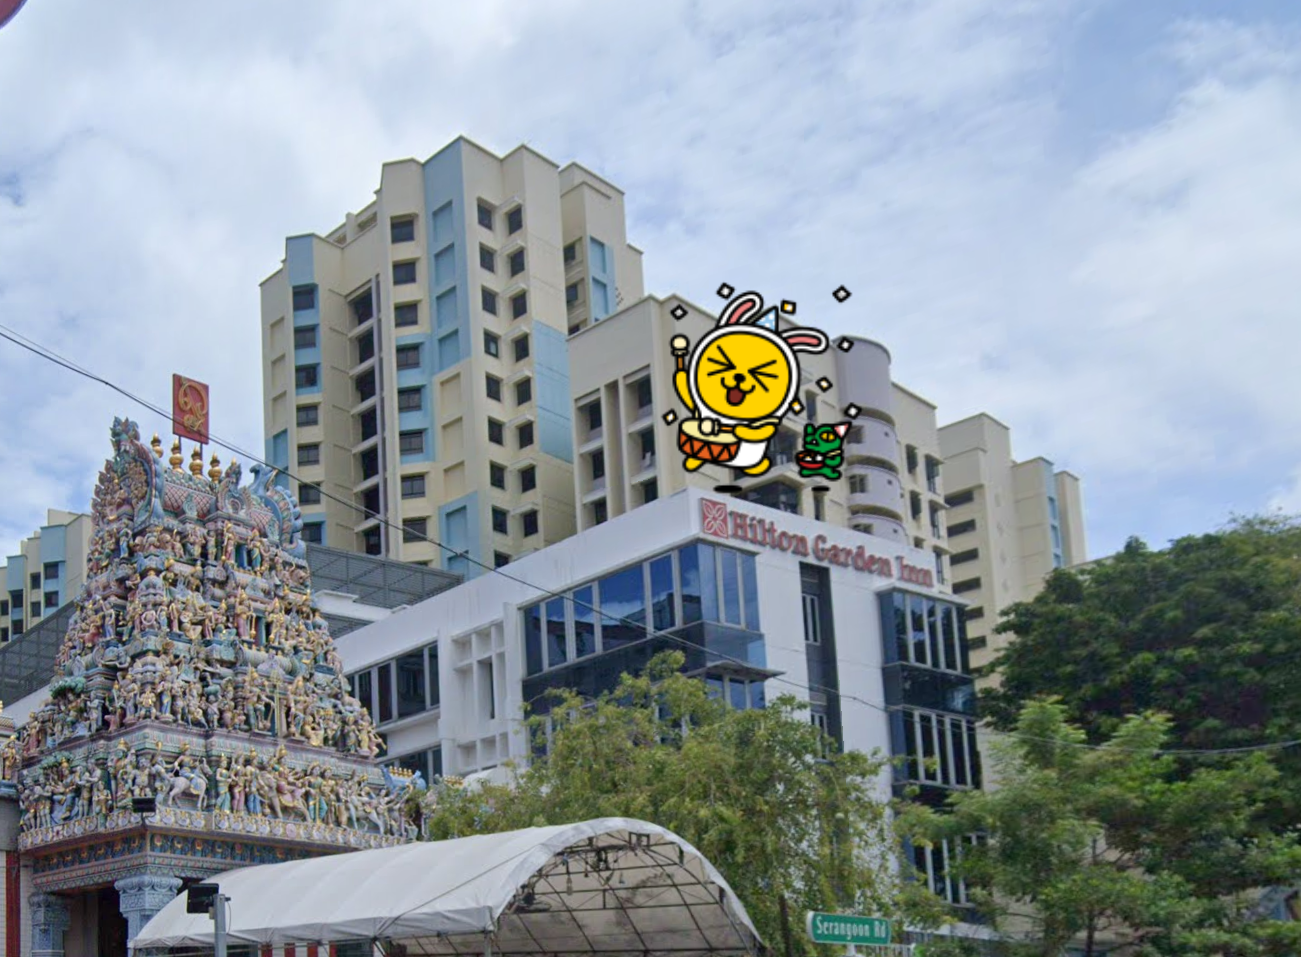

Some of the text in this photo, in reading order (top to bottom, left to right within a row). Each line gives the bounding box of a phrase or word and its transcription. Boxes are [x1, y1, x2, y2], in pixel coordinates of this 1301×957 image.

[730, 510, 934, 588] Hilton Garden Inn
[816, 915, 886, 941] Serangoon Rd
